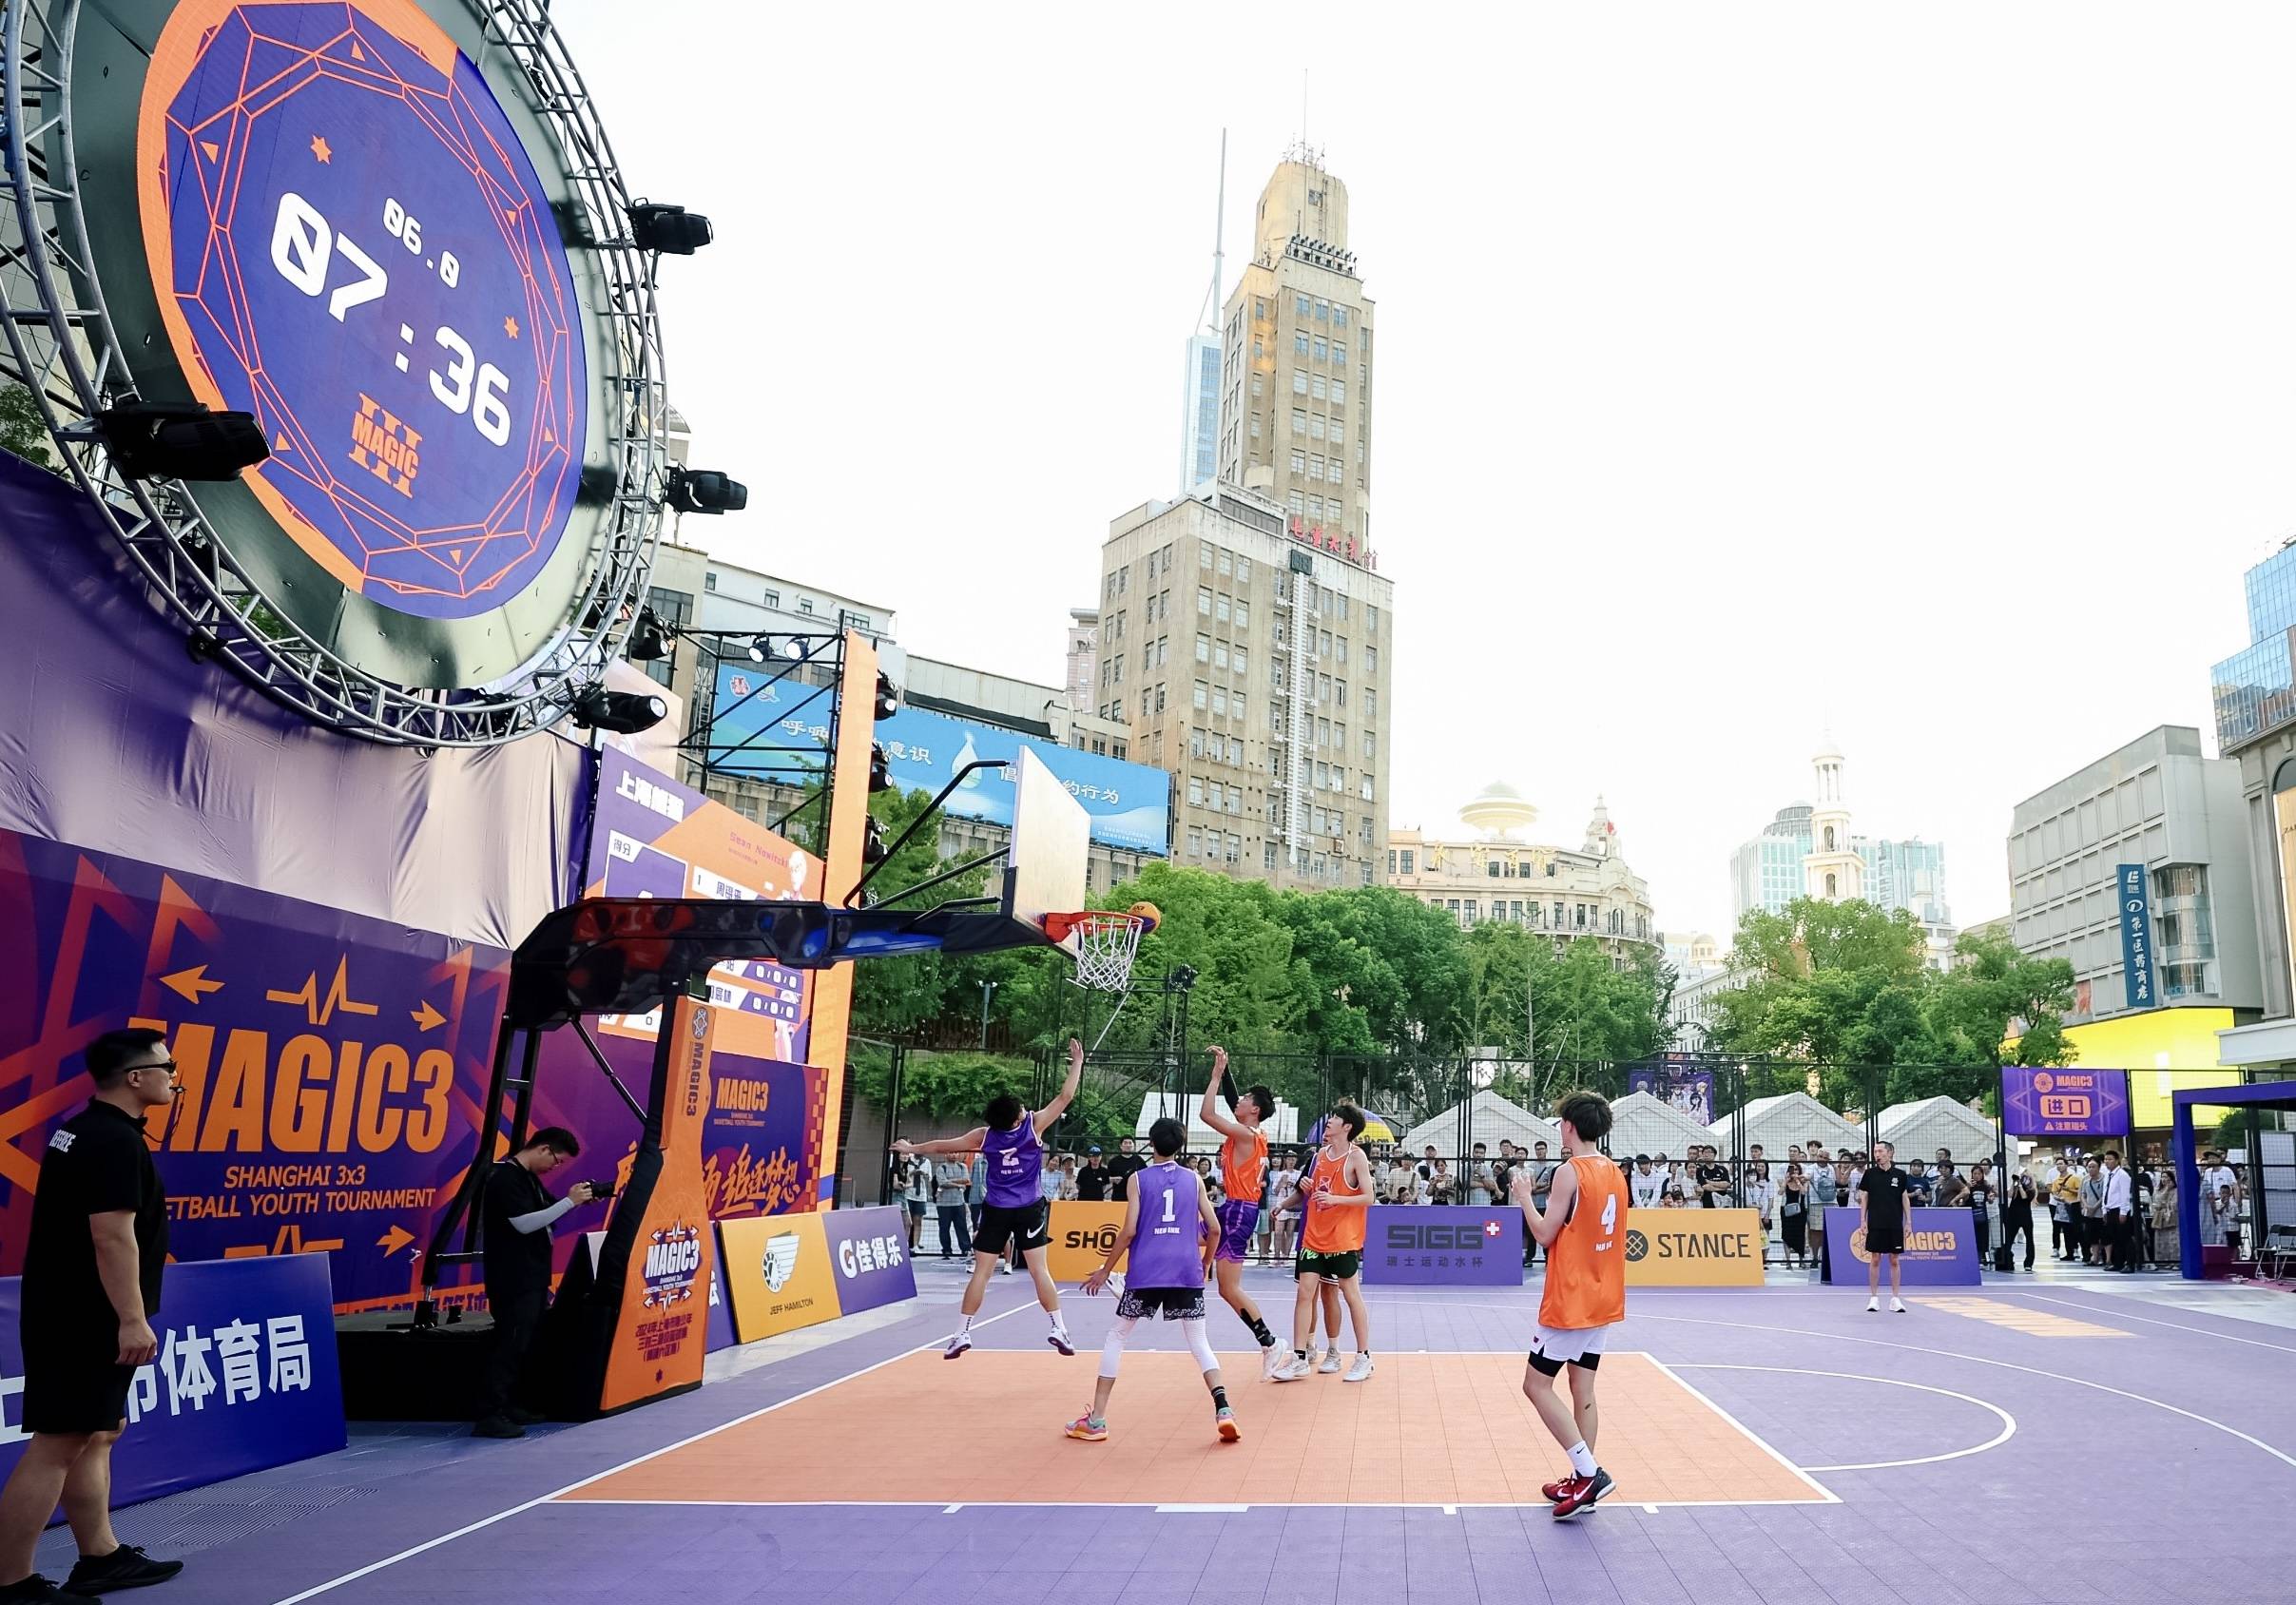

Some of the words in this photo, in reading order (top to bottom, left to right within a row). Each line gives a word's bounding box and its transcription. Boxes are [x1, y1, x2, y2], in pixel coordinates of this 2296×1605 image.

[383, 198, 460, 288] 06.0
[271, 193, 511, 446] 07:36
[351, 411, 418, 480] MAGIC
[781, 720, 933, 764] 呼唤意识
[998, 766, 1119, 804] 倡约行为
[686, 1042, 704, 1116] MAGIC3
[715, 1077, 769, 1112] MAGIC3
[2056, 1075, 2093, 1087] MAGIC3
[2048, 1099, 2084, 1115] 进口
[223, 1165, 331, 1189] SHANGHAI
[335, 1166, 366, 1187] 3x3
[165, 1194, 241, 1221] ETBALL
[250, 1191, 318, 1217] YOUTH
[324, 1188, 436, 1211] TOURNAMENT
[1162, 1189, 1176, 1223] 1
[1601, 1194, 1616, 1235] 4
[857, 1234, 903, 1273] 佳得乐
[1065, 1230, 1116, 1249] SHO
[1387, 1225, 1483, 1249] SIGG
[1657, 1233, 1751, 1258] STANCE
[1903, 1231, 1957, 1251] AGIC3
[646, 1239, 700, 1278] MAGIC3
[1386, 1256, 1483, 1268] 瑞士运动水杯
[769, 1304, 783, 1315] JEFF
[784, 1298, 814, 1312] HAMILTON
